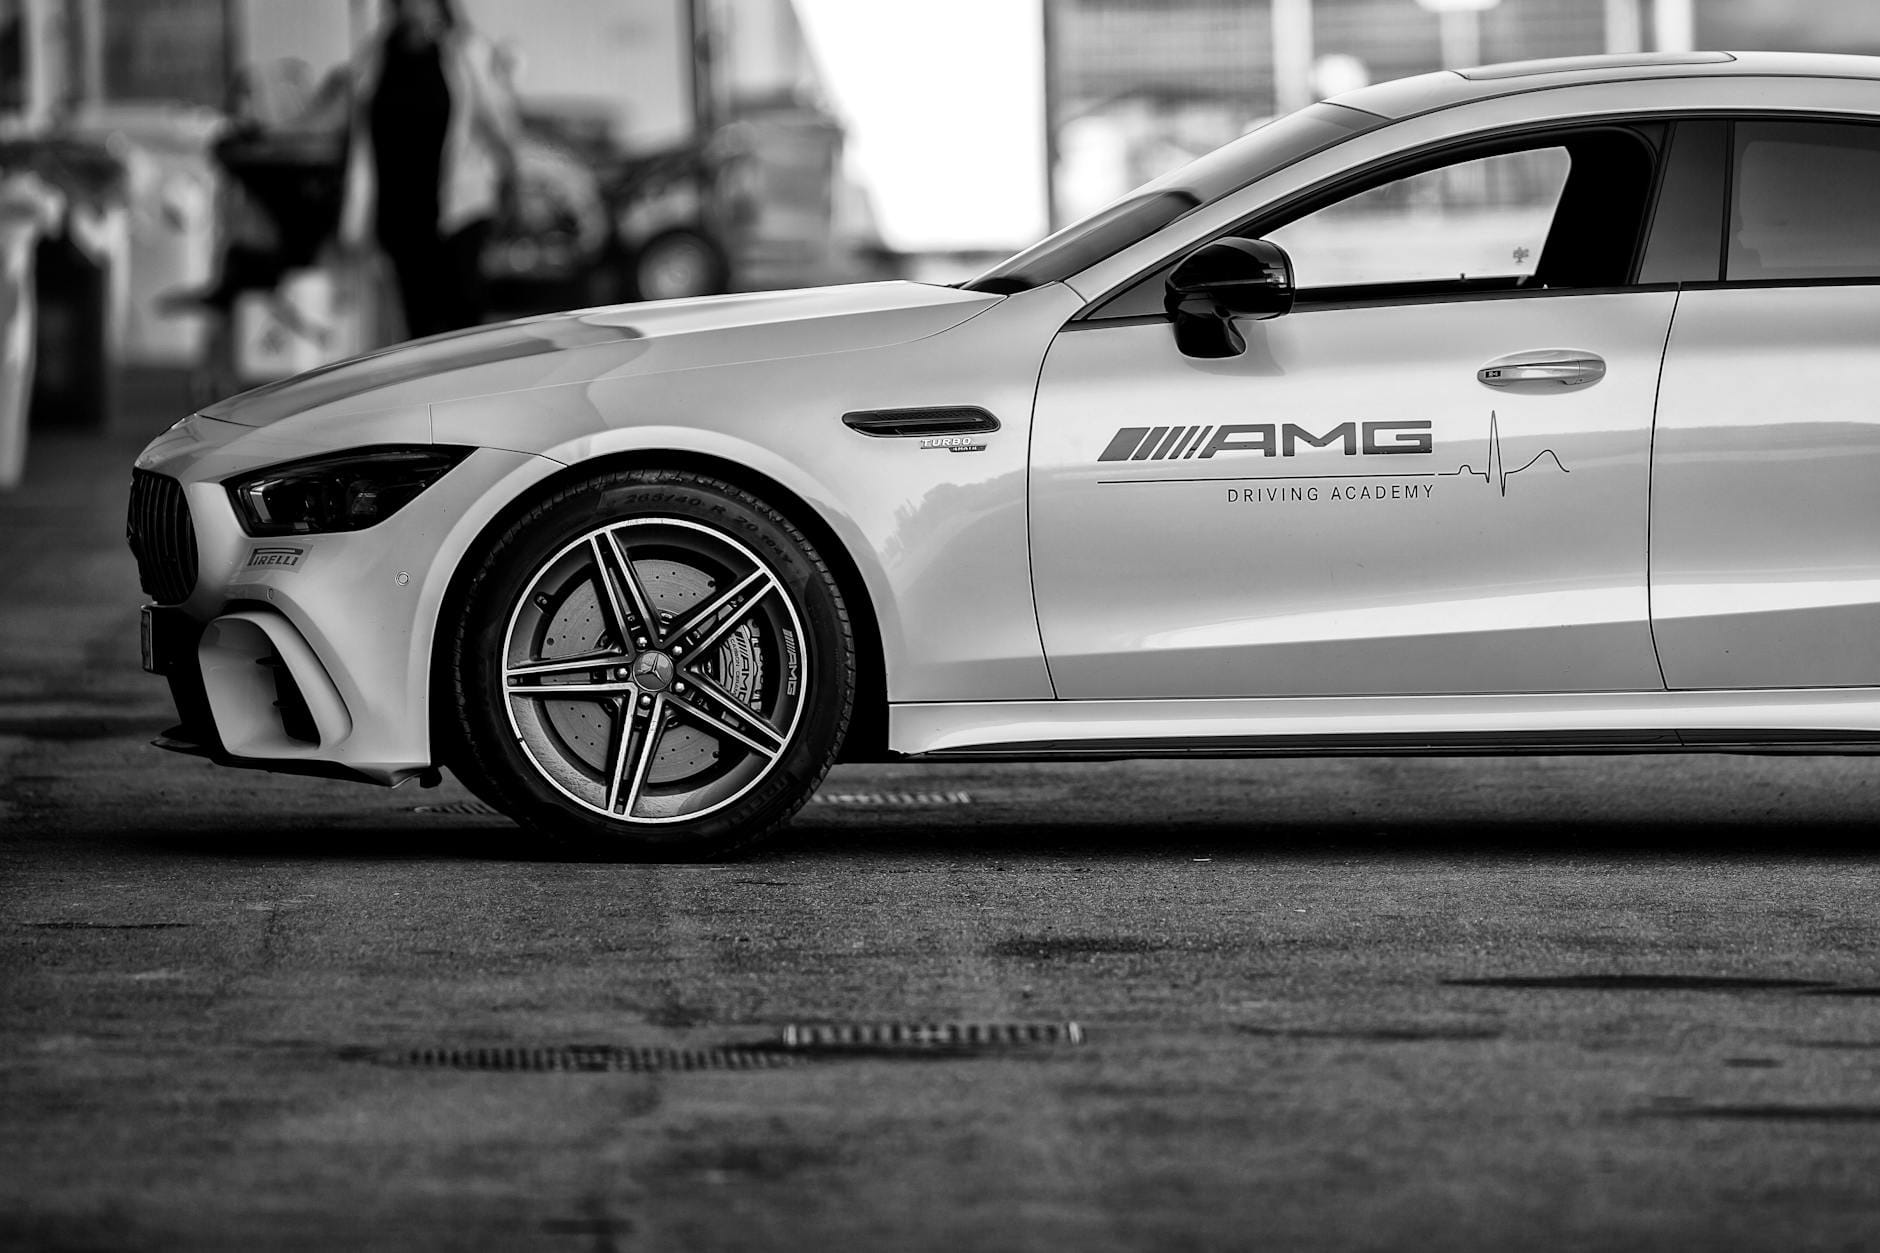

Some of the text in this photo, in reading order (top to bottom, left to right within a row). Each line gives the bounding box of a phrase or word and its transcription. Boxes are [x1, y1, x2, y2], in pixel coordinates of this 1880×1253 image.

[922, 437, 972, 447] TURBO
[1198, 420, 1432, 459] AMG
[1227, 484, 1434, 503] DRIVING ACADEMY
[247, 547, 304, 567] PIRELLI
